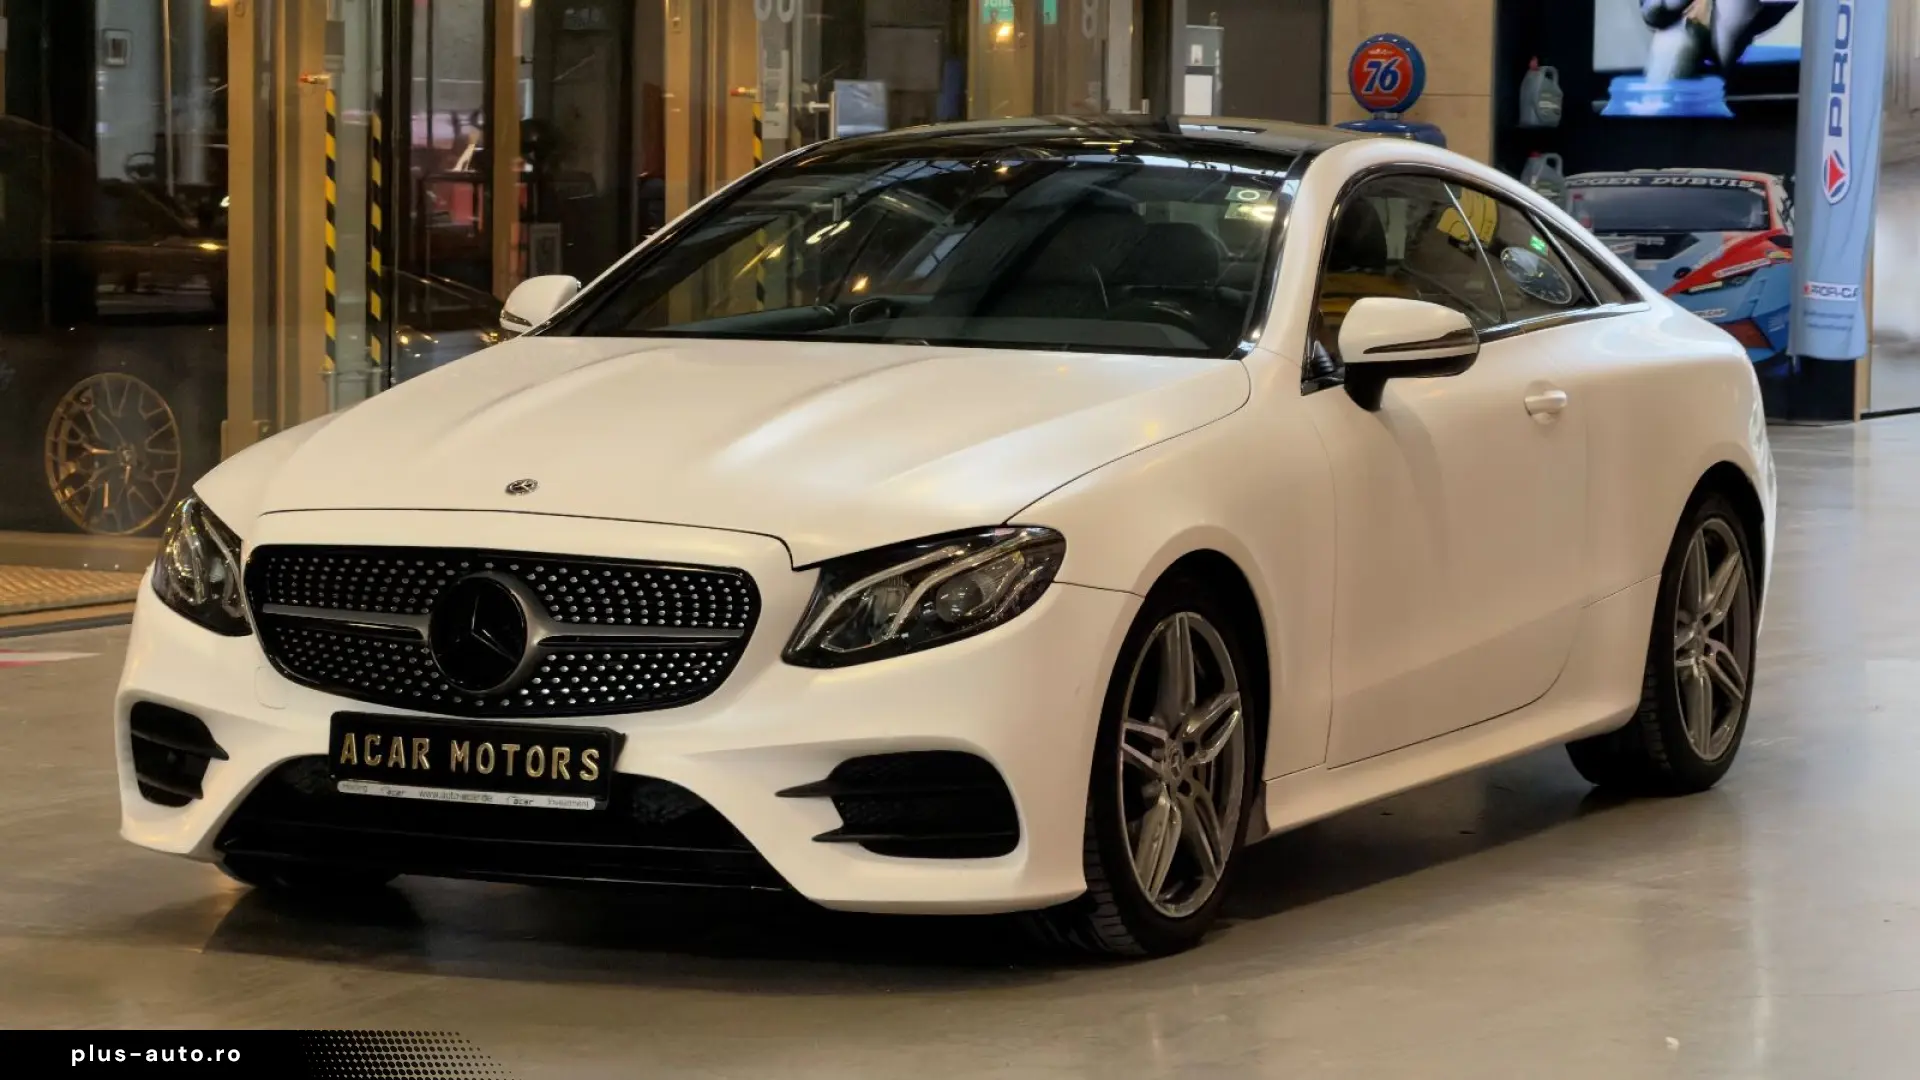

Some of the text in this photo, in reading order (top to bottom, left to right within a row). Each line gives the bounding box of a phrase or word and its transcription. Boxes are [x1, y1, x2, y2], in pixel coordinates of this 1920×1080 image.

[1362, 57, 1404, 95] 76
[1650, 176, 1755, 188] DUBUIS
[340, 732, 600, 782] ACAR MOTORS
